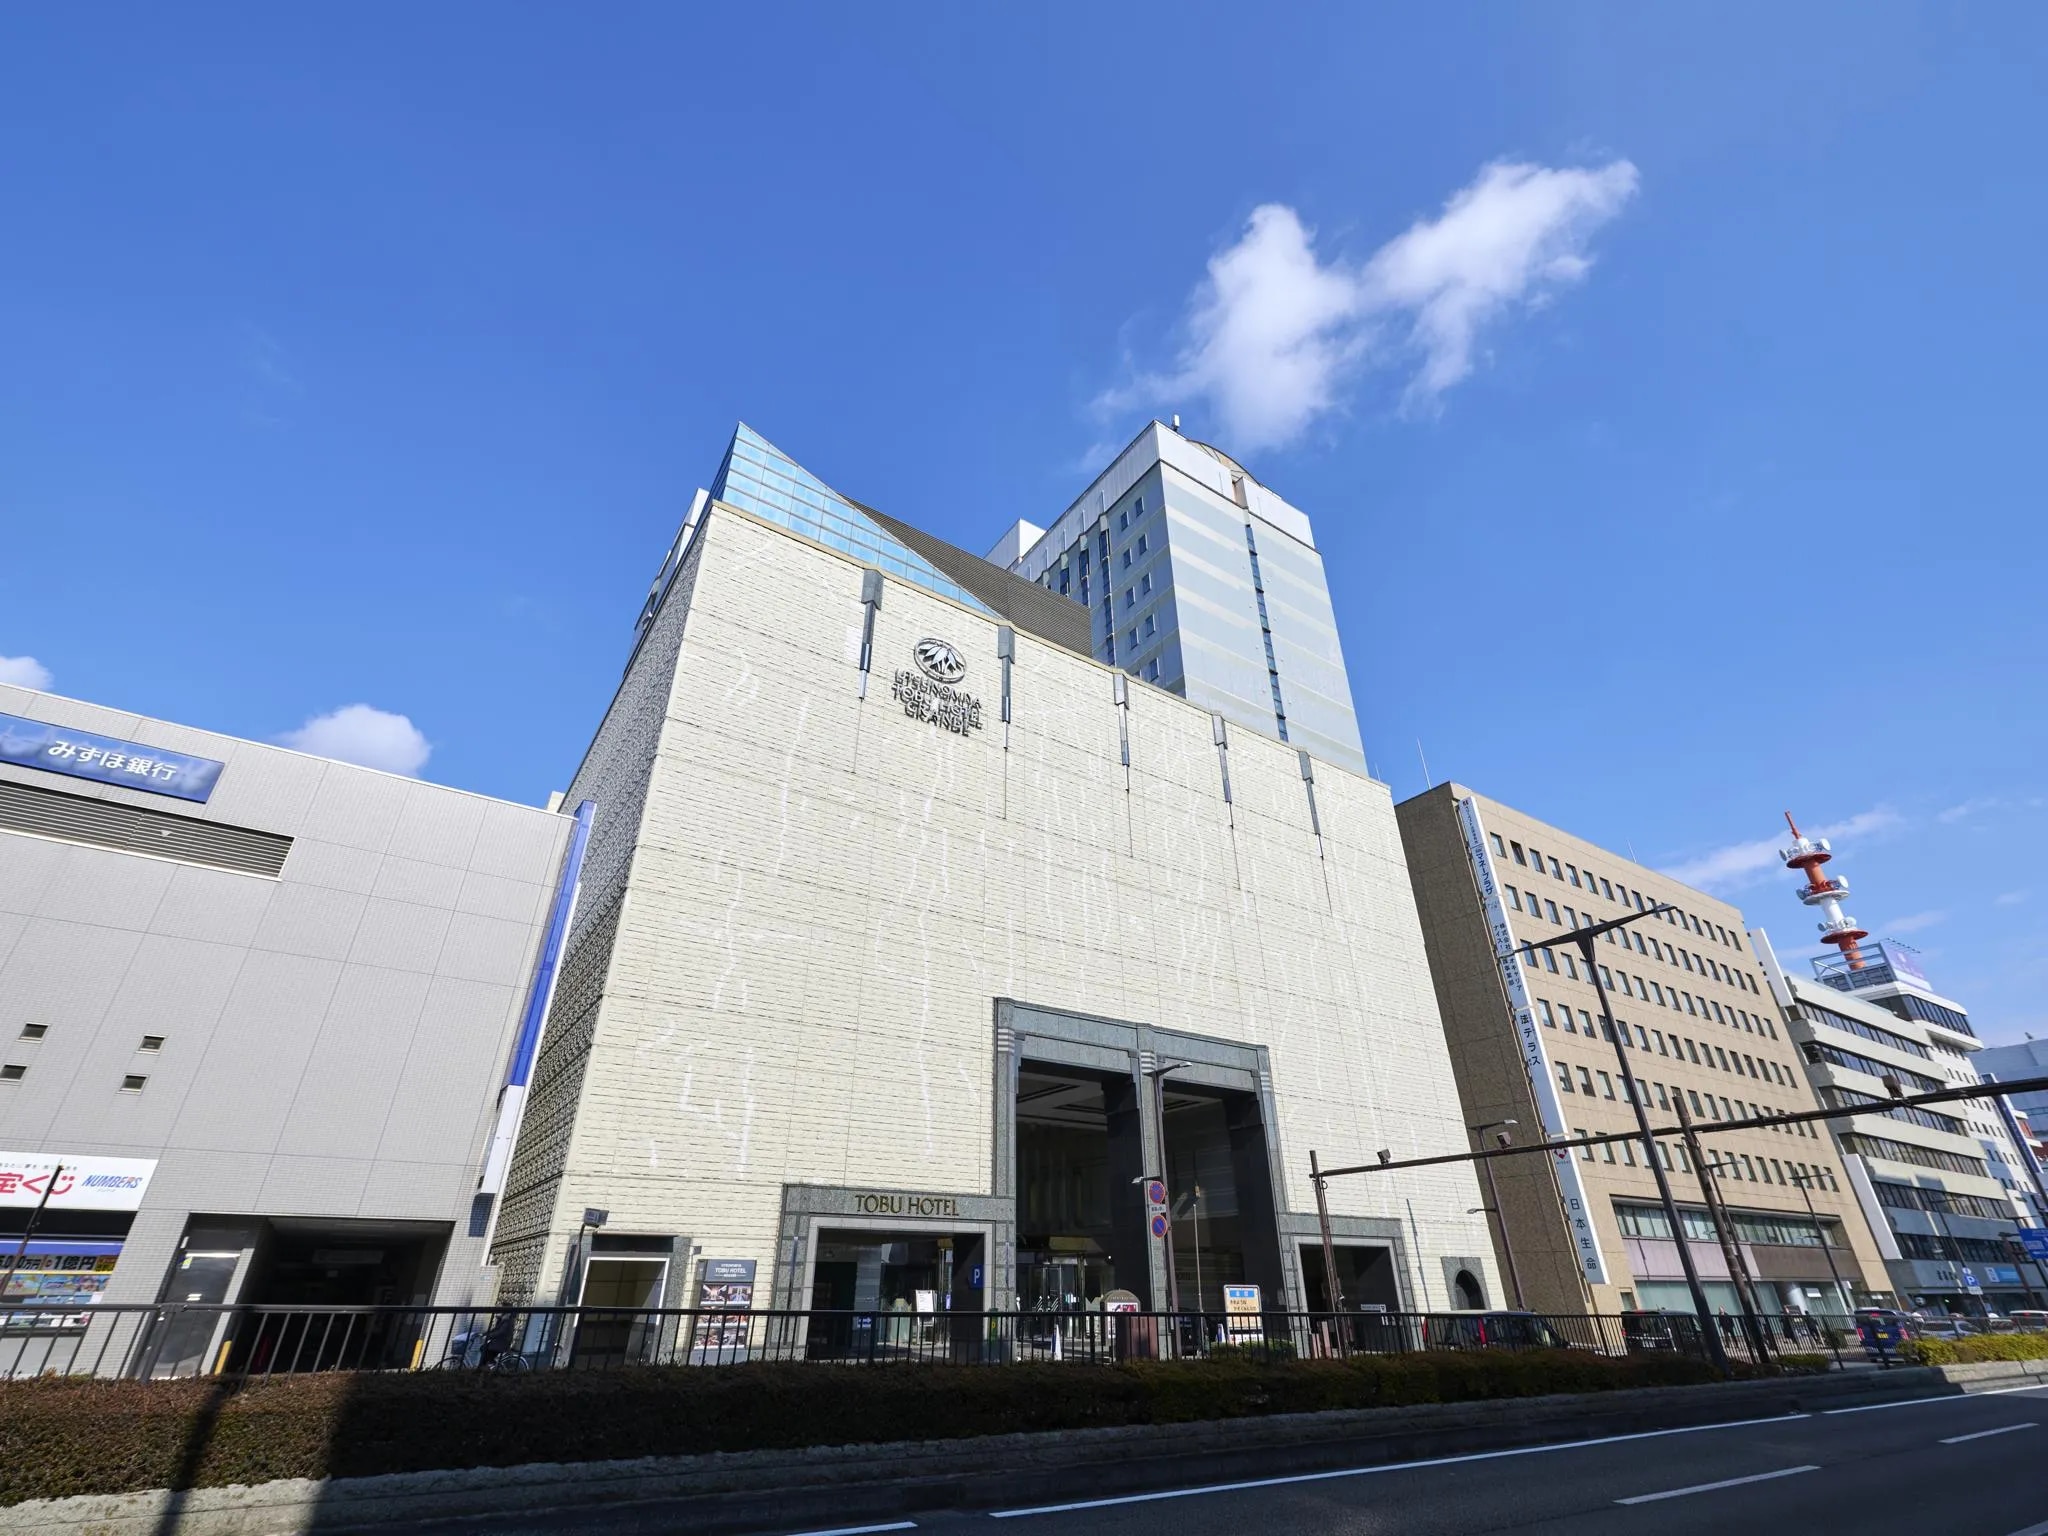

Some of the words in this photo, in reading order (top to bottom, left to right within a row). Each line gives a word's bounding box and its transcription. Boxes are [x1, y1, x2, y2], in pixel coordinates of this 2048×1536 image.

[48, 740, 178, 781] みずほ銀行
[1519, 1014, 1541, 1066] 法テラス
[82, 1174, 143, 1189] NUMBERS
[855, 1193, 902, 1214] TOBU
[907, 1197, 960, 1217] HOTEL
[1570, 1198, 1597, 1270] 日本生命
[973, 1268, 981, 1284] P
[1967, 1275, 1976, 1285] P
